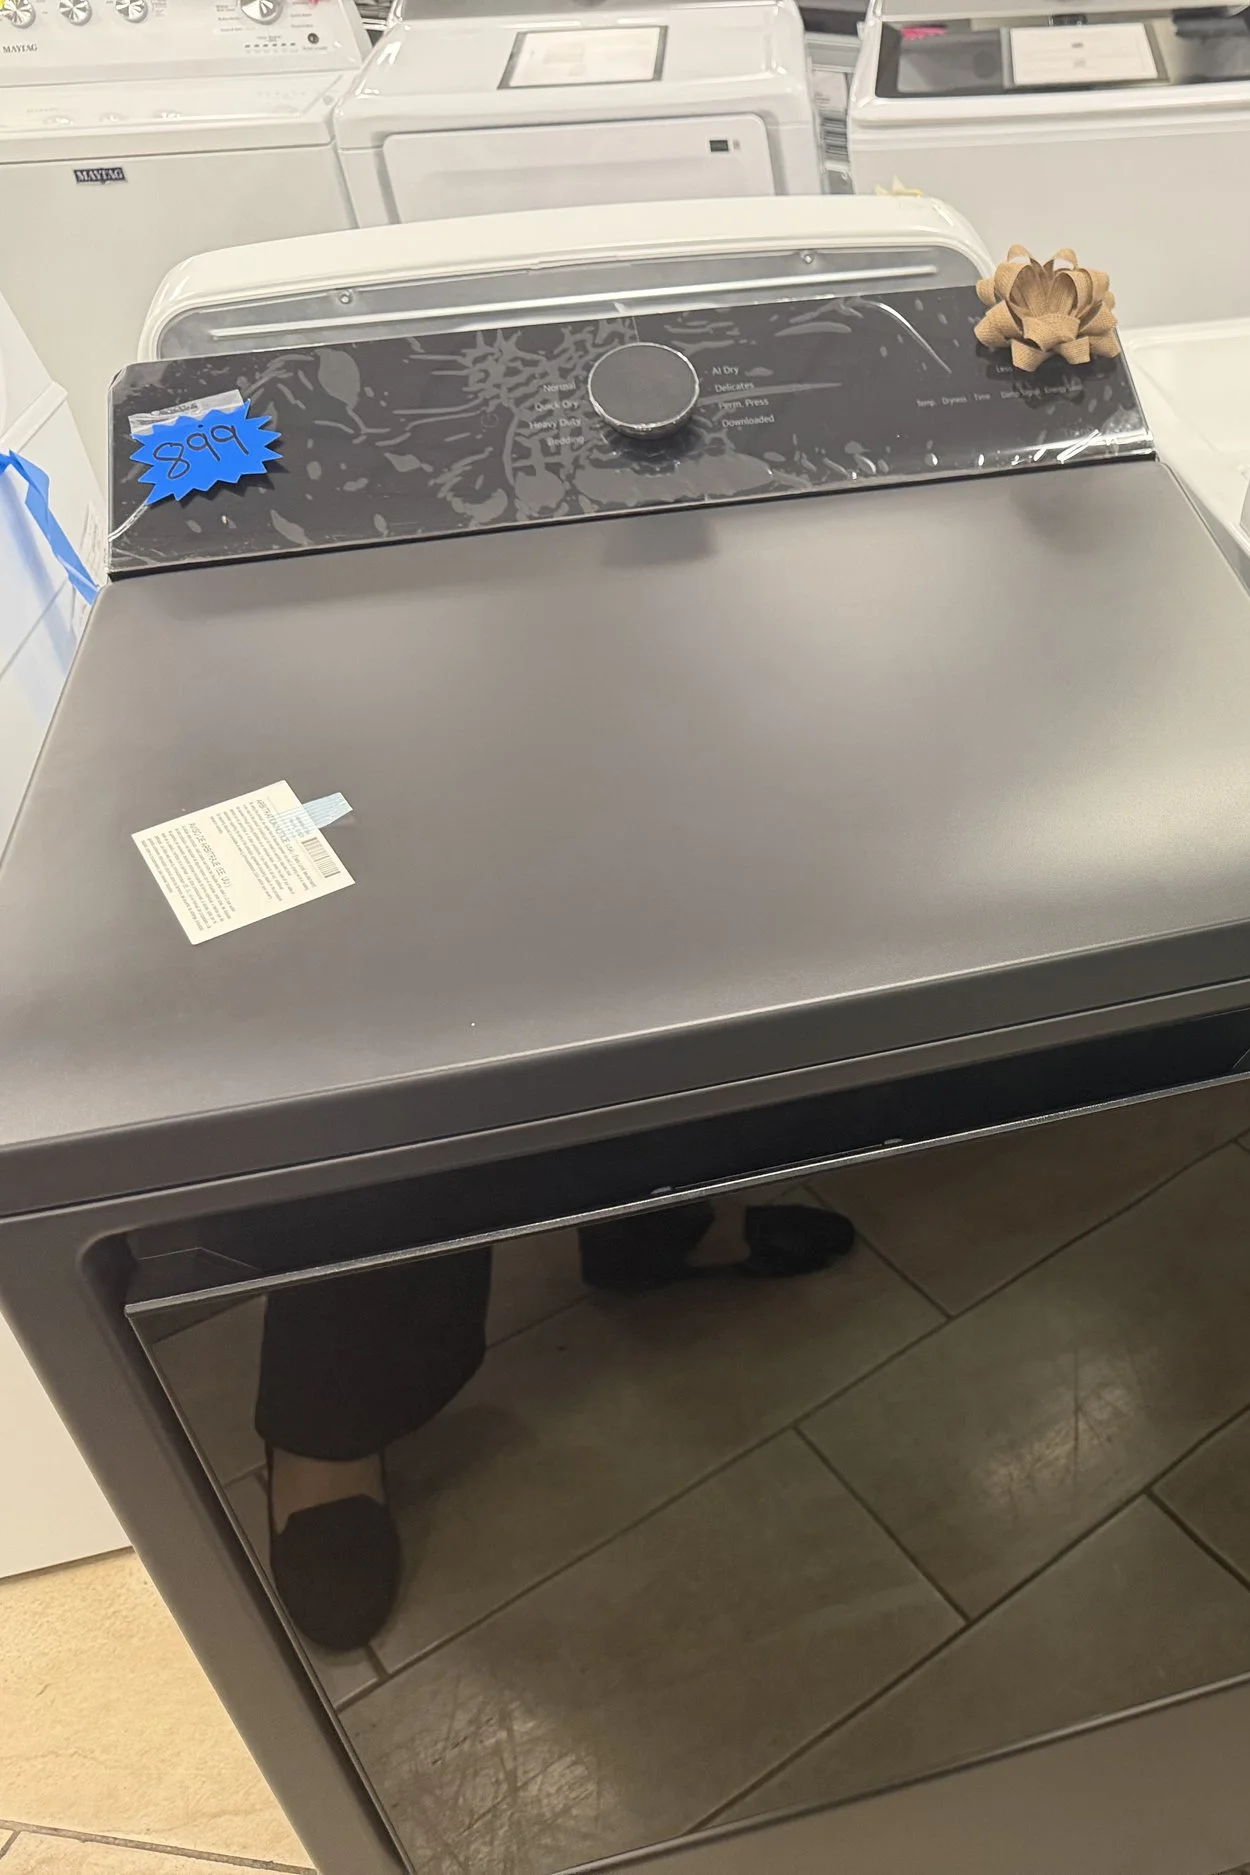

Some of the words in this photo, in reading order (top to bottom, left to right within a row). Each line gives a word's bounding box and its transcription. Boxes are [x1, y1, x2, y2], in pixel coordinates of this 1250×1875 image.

[3, 44, 38, 54] MAYTAG
[75, 169, 123, 183] MAYTAG
[723, 365, 739, 376] Dry
[543, 382, 576, 392] Normal
[714, 382, 755, 393] Delicates
[562, 400, 579, 409] Dry
[744, 398, 769, 407] Press
[529, 420, 557, 430] Heavy
[559, 417, 582, 428] Duty
[721, 414, 775, 427] Downloaded
[152, 424, 249, 480] 899
